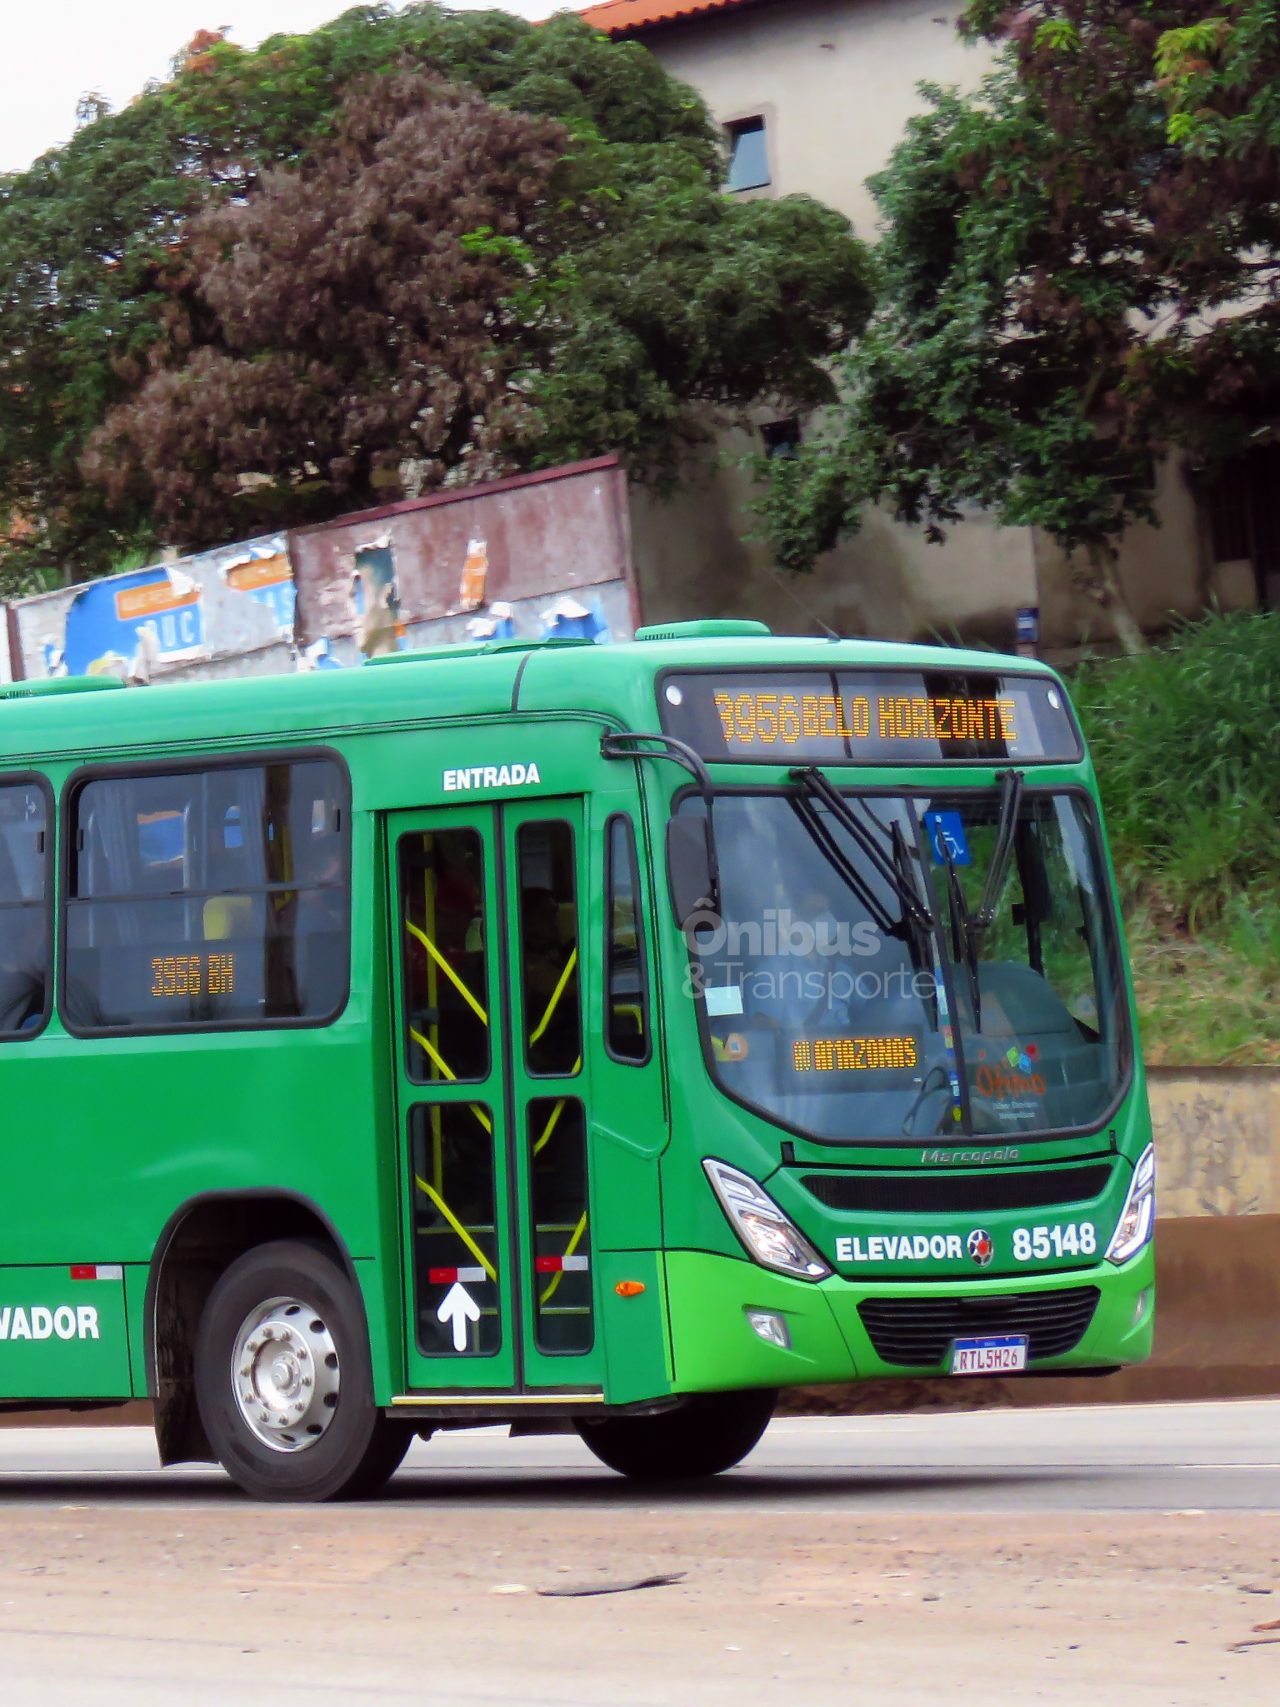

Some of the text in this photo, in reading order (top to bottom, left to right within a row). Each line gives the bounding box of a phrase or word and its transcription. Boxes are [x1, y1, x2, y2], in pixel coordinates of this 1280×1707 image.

[714, 693, 1017, 743] 3956 BELO HORIZONTE
[443, 762, 541, 792] ENTRADA
[151, 953, 233, 997] 3956 BH
[814, 1037, 916, 1070] AMAZONAS
[920, 1145, 1020, 1165] Marcopolo
[835, 1222, 1097, 1262] ELEVADOR 85148
[959, 1348, 1018, 1370] RTL5H26
